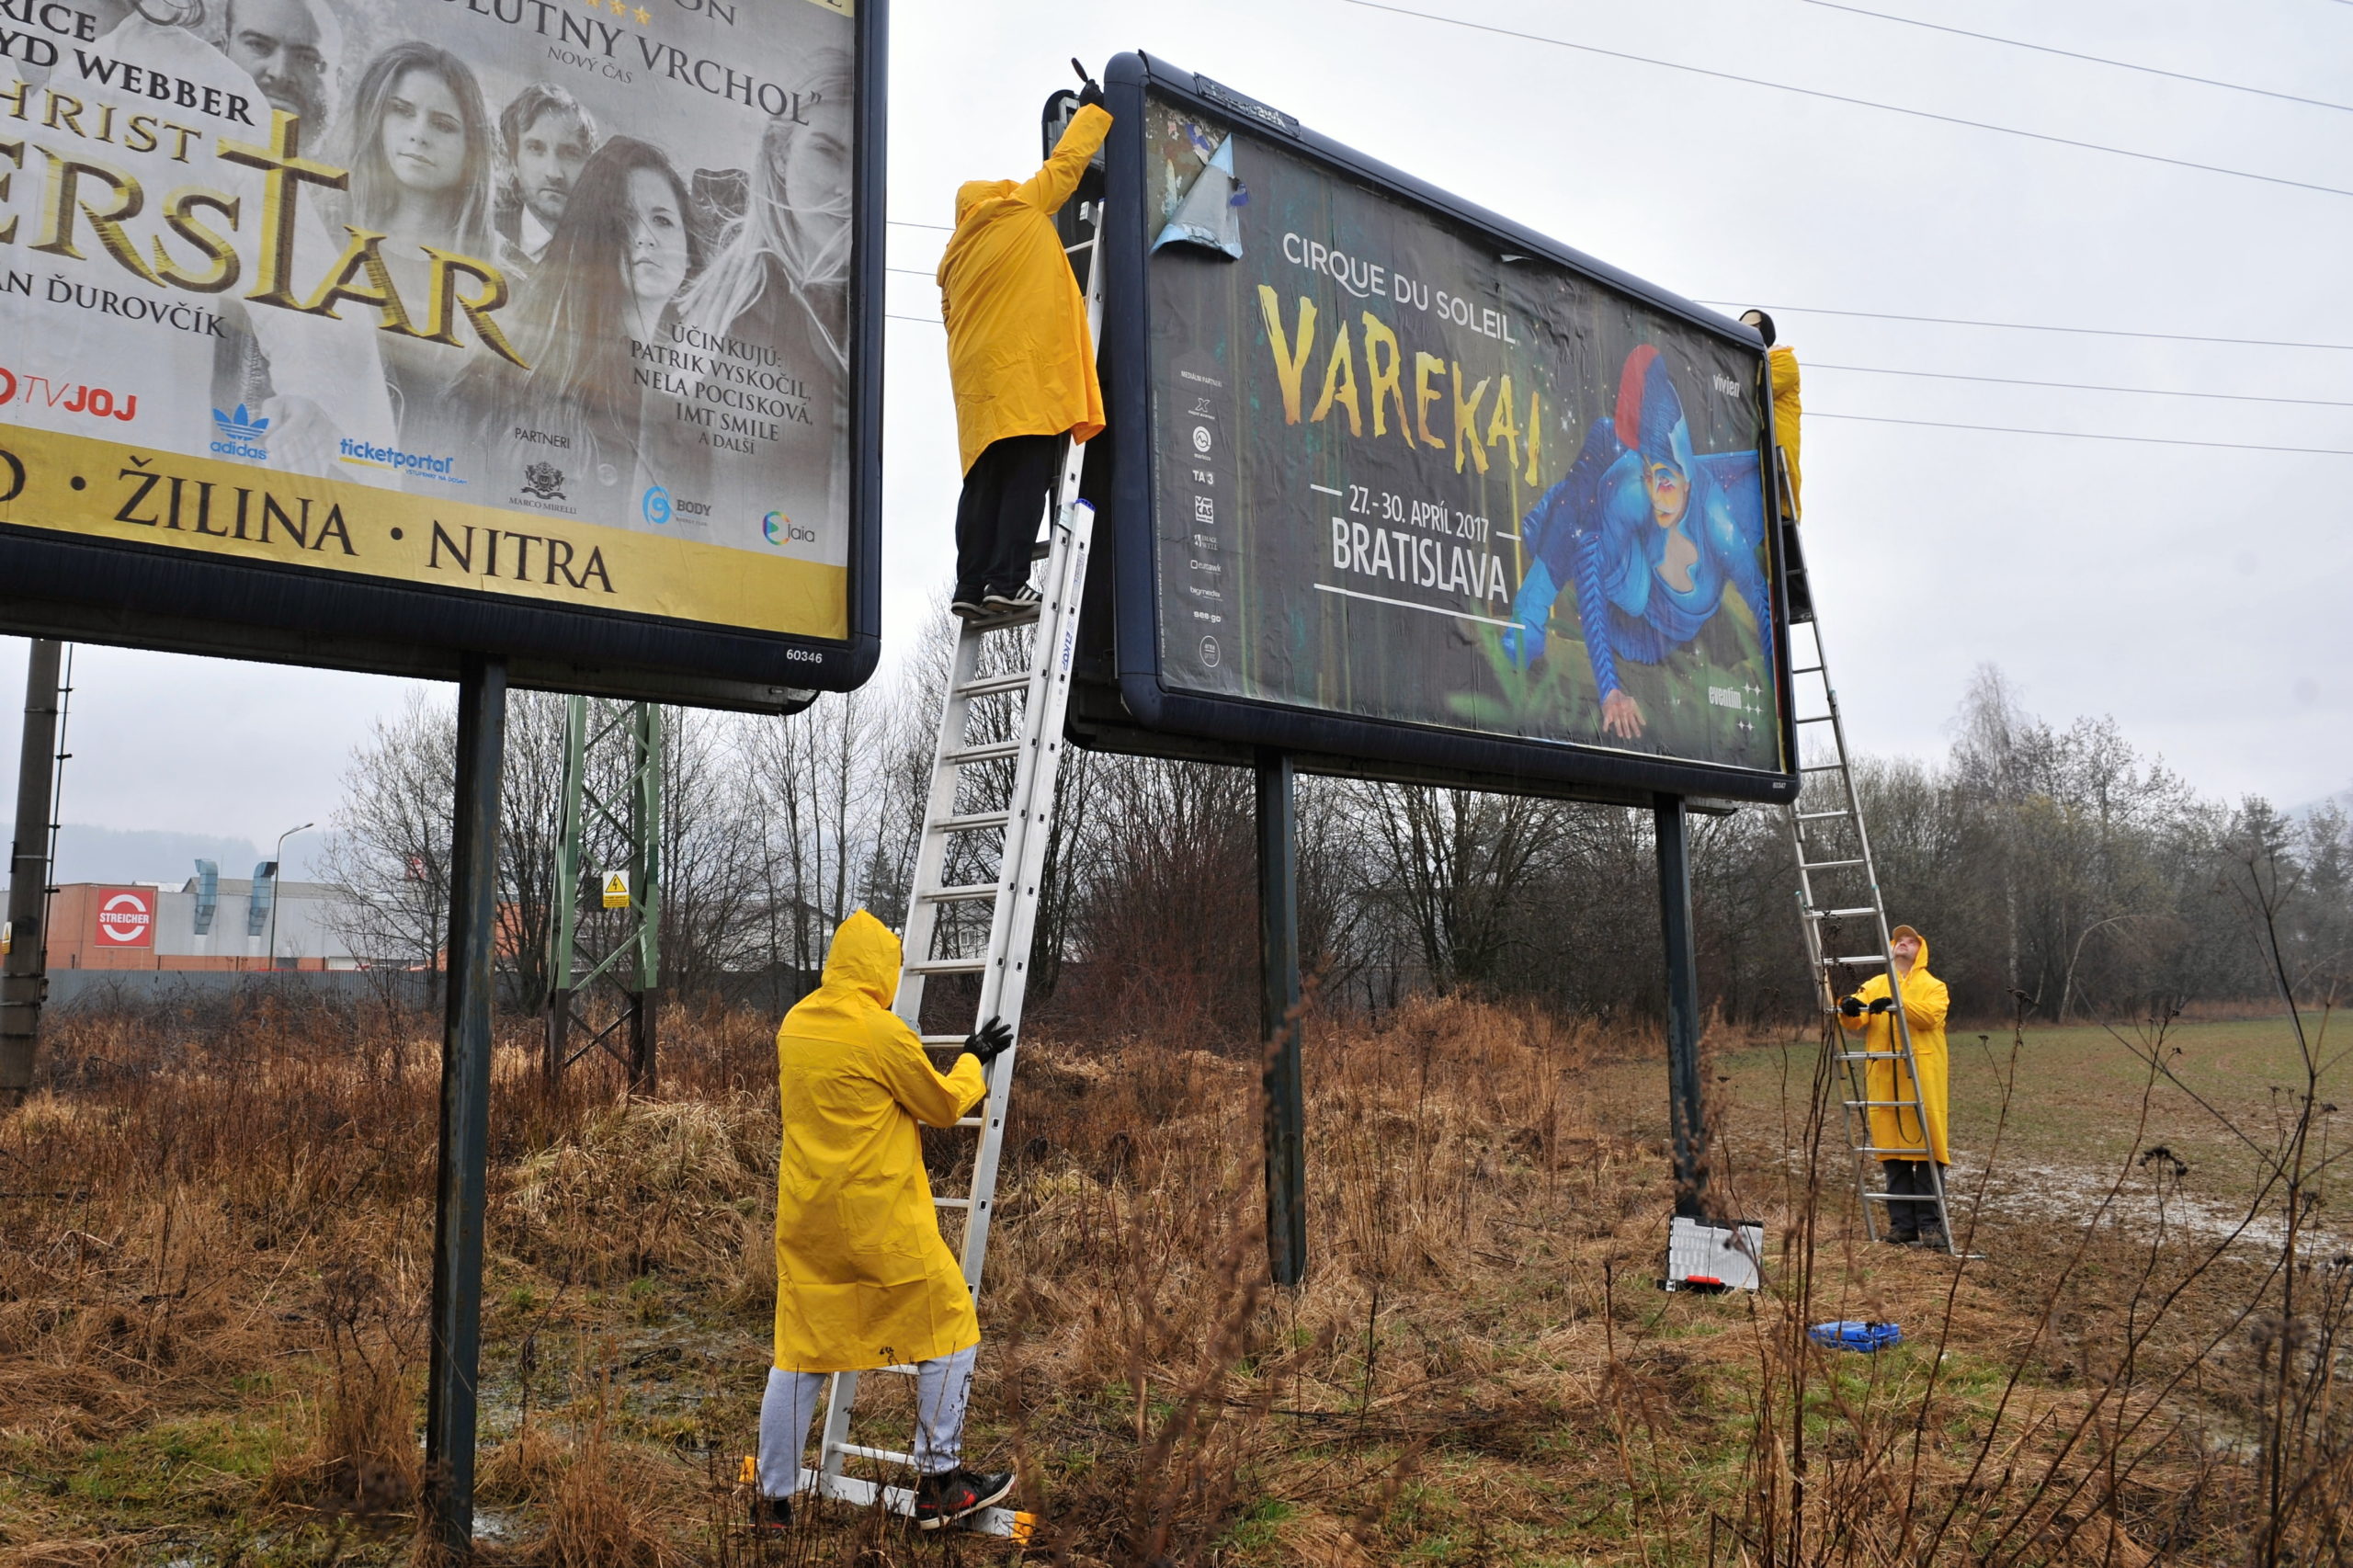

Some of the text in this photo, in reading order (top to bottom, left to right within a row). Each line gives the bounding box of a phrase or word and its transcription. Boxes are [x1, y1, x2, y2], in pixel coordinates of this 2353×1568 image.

[547, 46, 632, 85] NOVÝ ČAS
[74, 48, 256, 127] WEBBER
[47, 273, 227, 339] ĎUROVČÍK
[1283, 233, 1516, 344] CIRQUE DU SOLEIL
[670, 322, 781, 368] ÚČINKUJÚ:
[631, 340, 812, 402] PATRIK VYSKOČIL,
[1257, 284, 1541, 487] VAREKAI
[1712, 373, 1740, 398] vivien
[633, 369, 813, 426] NELA POCISKOVÁ,
[515, 427, 570, 449] PARTNERI
[676, 403, 779, 442] IMT SMILE
[699, 432, 710, 445] A
[210, 441, 267, 460] adidas
[339, 438, 453, 473] ticketportal
[114, 455, 360, 556] ŽILINA
[508, 497, 577, 515] MARCO MIRELLI
[676, 499, 711, 517] BODY
[1411, 499, 1452, 535] APRÍL
[1456, 511, 1490, 543] 2017
[426, 519, 619, 594] NITRA
[1332, 516, 1509, 604] BRATISLAVA
[786, 648, 824, 664] 60346
[1708, 686, 1742, 710] eventim
[99, 912, 150, 925] STREICHER
